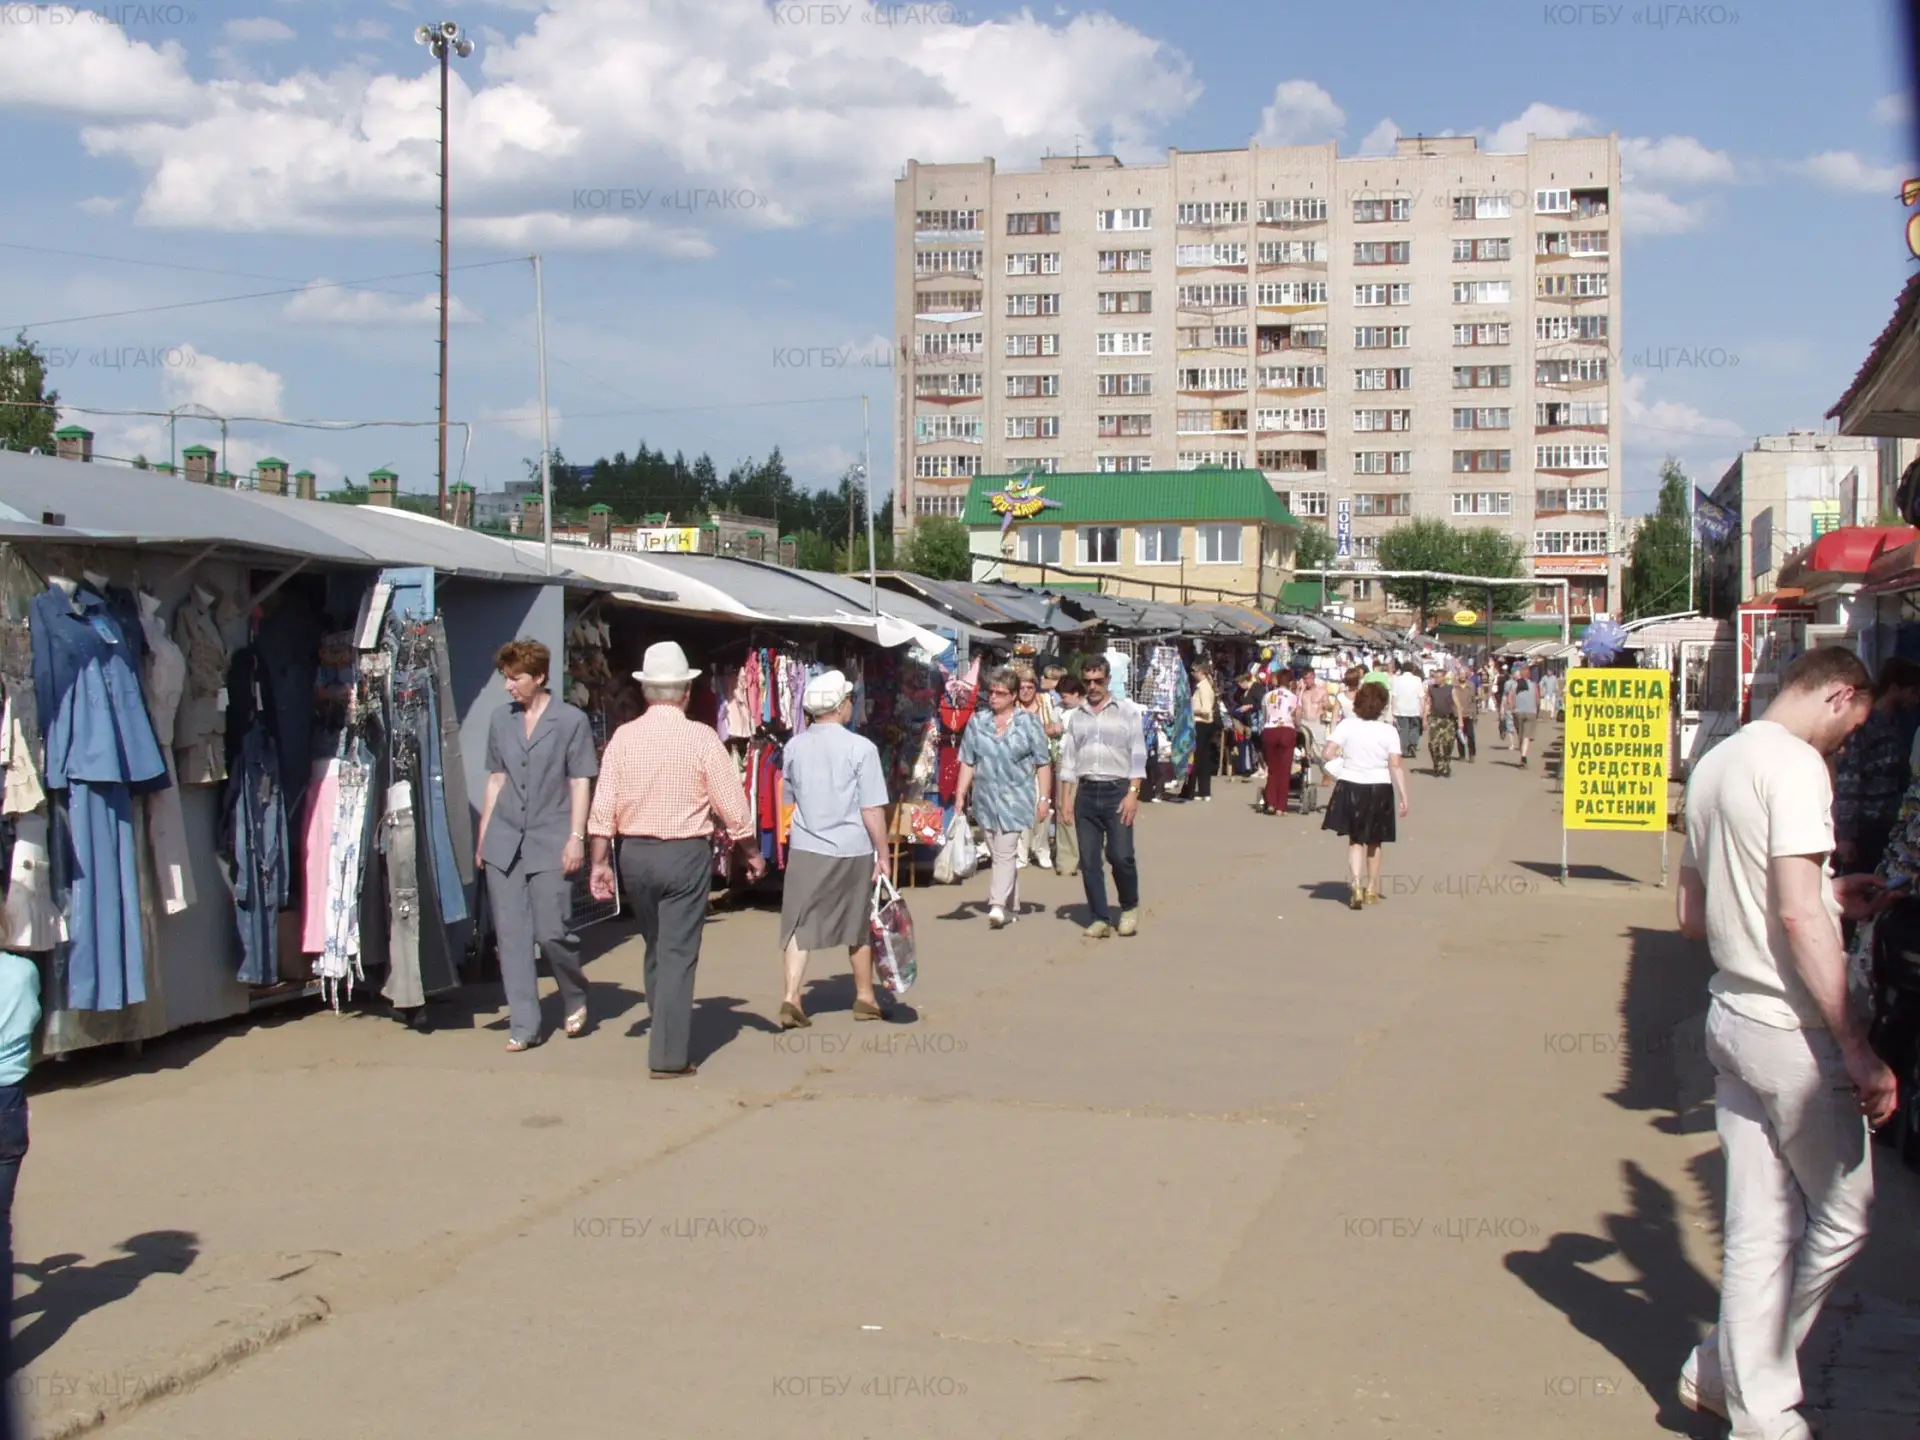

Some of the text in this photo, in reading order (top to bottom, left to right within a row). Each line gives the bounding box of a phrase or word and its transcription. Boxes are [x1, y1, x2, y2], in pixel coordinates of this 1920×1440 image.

[1339, 501, 1350, 555] ПОЧТА
[1569, 679, 1664, 699] СЕМЕНА
[1572, 704, 1660, 722] ЛУКОВИЦЫ
[1587, 723, 1651, 740] ЦВЕТОВ
[1570, 742, 1664, 759] УДОБРЕНИЯ
[1578, 761, 1663, 778] СРЕДСТВА
[1580, 780, 1653, 797] ЗАЩИТЫ
